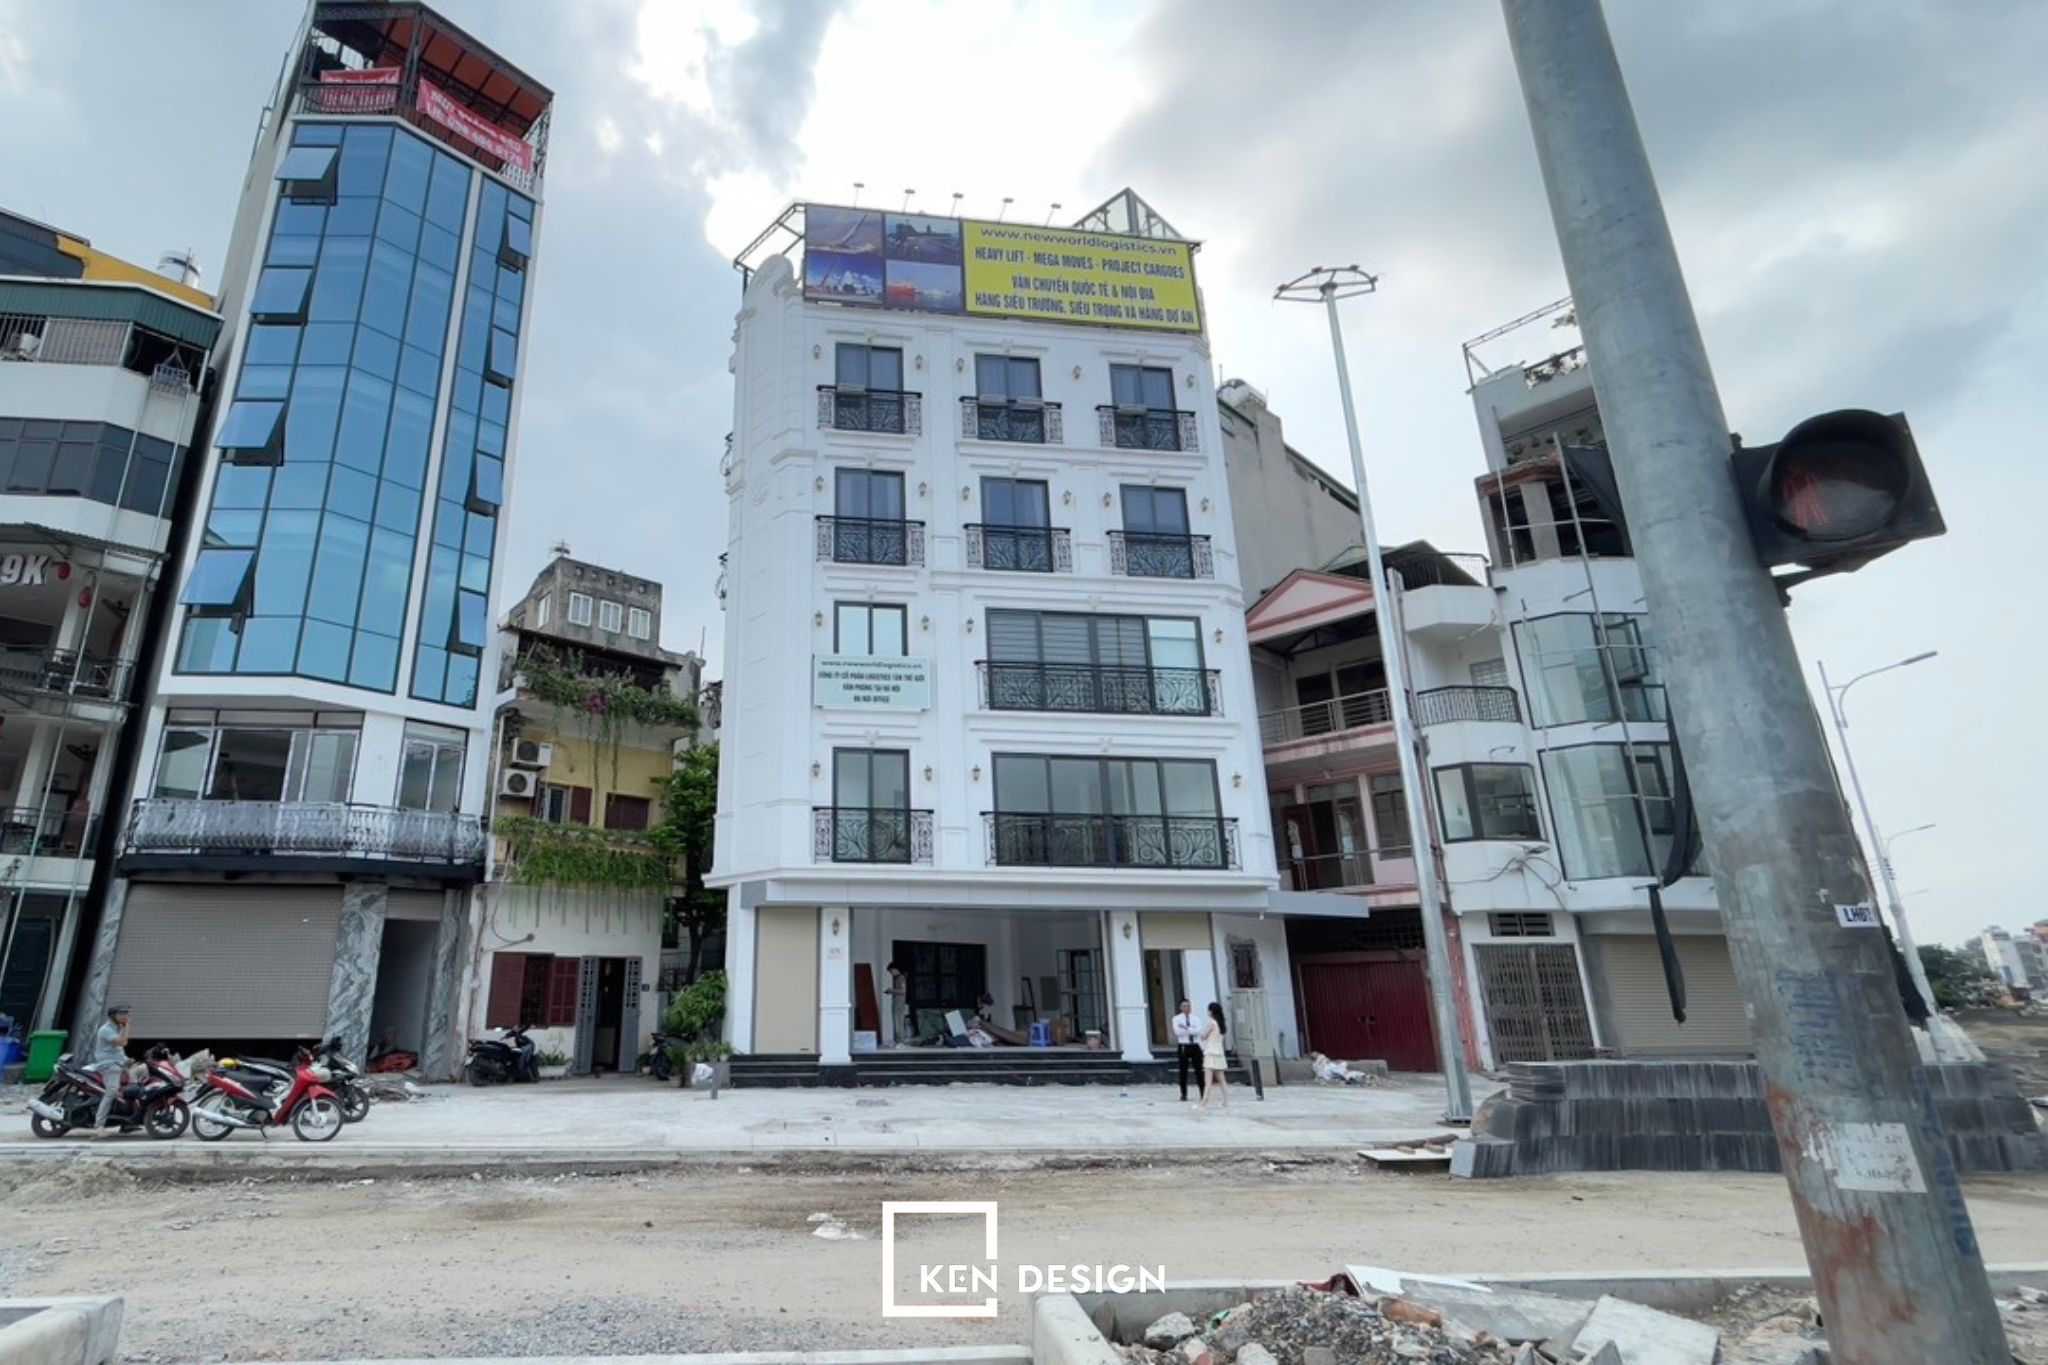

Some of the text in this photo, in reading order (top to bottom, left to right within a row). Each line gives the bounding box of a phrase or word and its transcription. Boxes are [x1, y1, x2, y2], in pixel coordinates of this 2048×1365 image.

[980, 228, 1177, 256] www.newworldlogistics.vn
[974, 246, 1003, 261] HEAVY
[1005, 249, 1025, 263] LIFT
[1033, 252, 1060, 266] MEGA
[1061, 254, 1094, 270] MOVES
[1102, 258, 1142, 274] PROJECT
[1143, 263, 1185, 279] CARGOES
